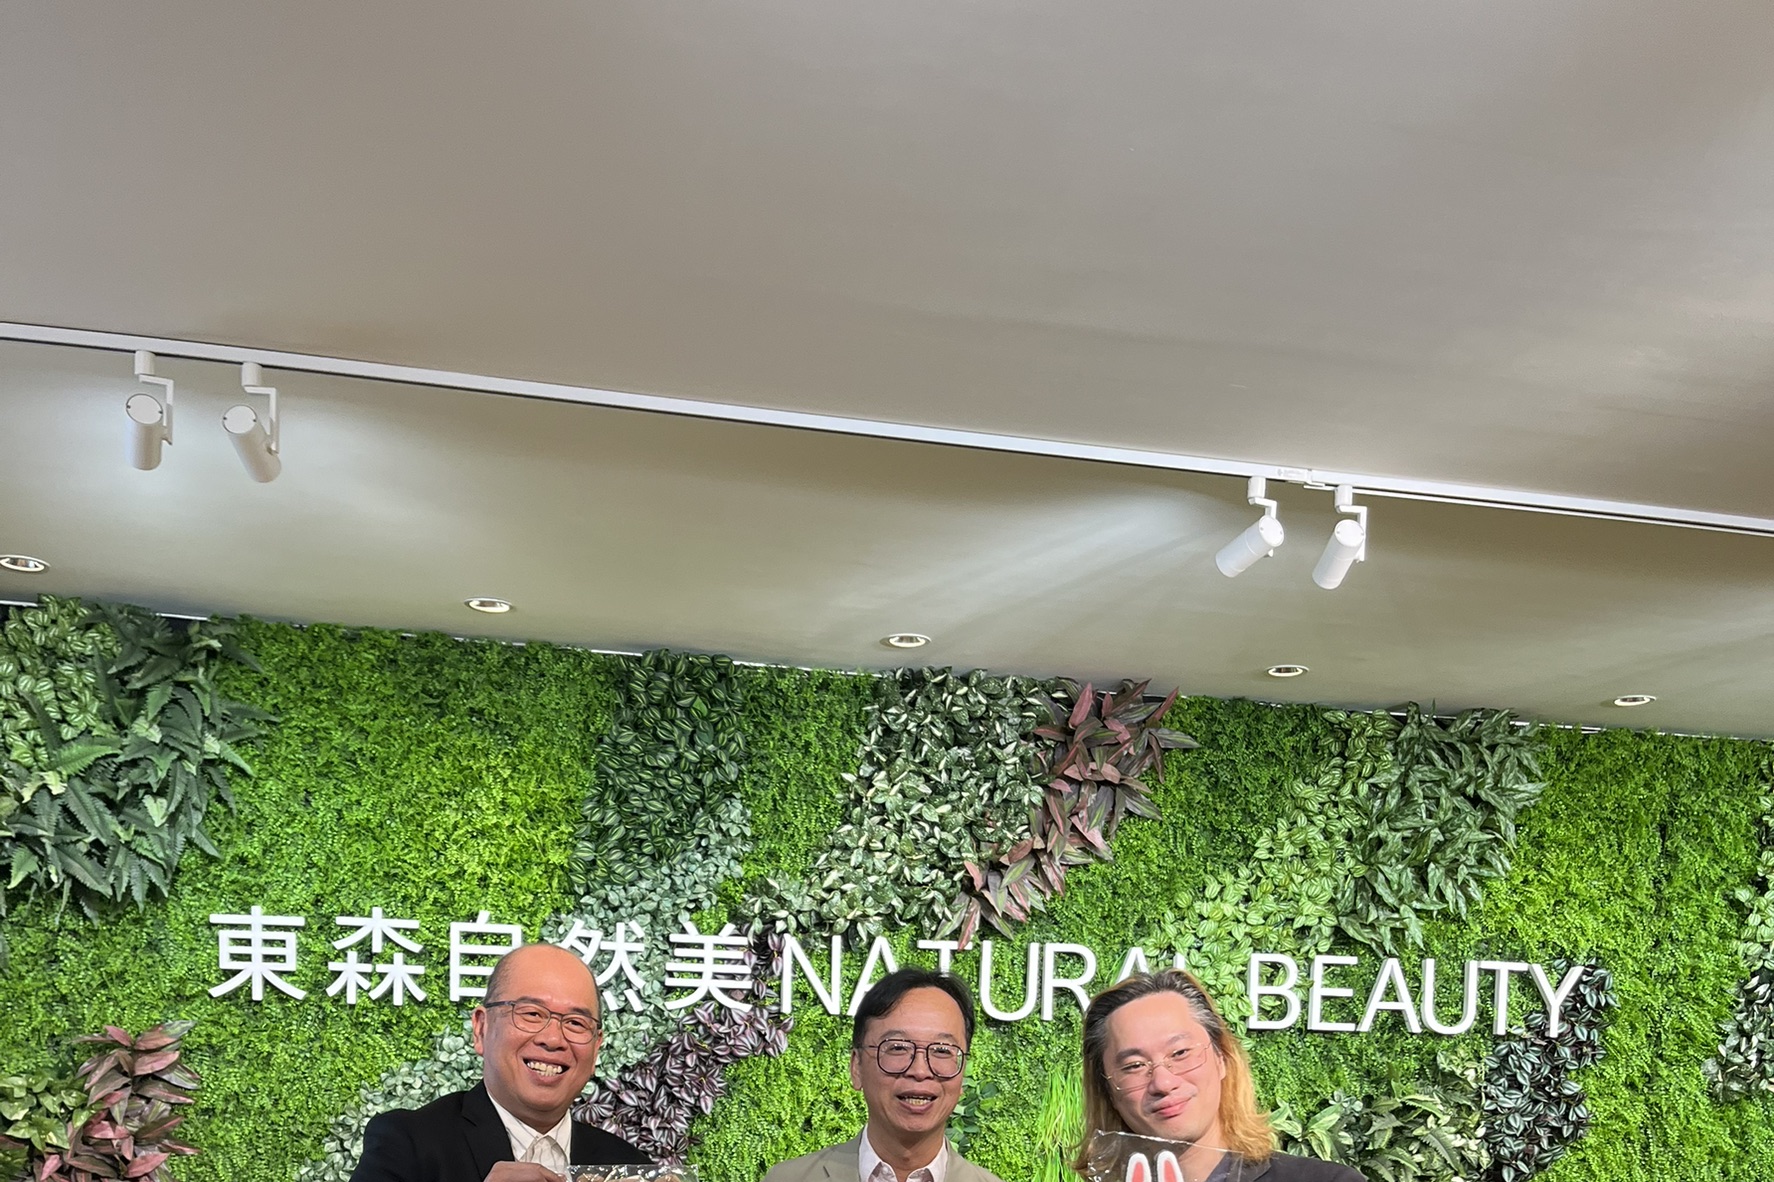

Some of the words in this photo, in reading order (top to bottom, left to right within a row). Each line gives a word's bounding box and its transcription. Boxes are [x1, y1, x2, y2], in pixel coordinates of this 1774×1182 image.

[208, 905, 755, 1013] 東森自然美
[1247, 951, 1585, 1038] BEAUTY
